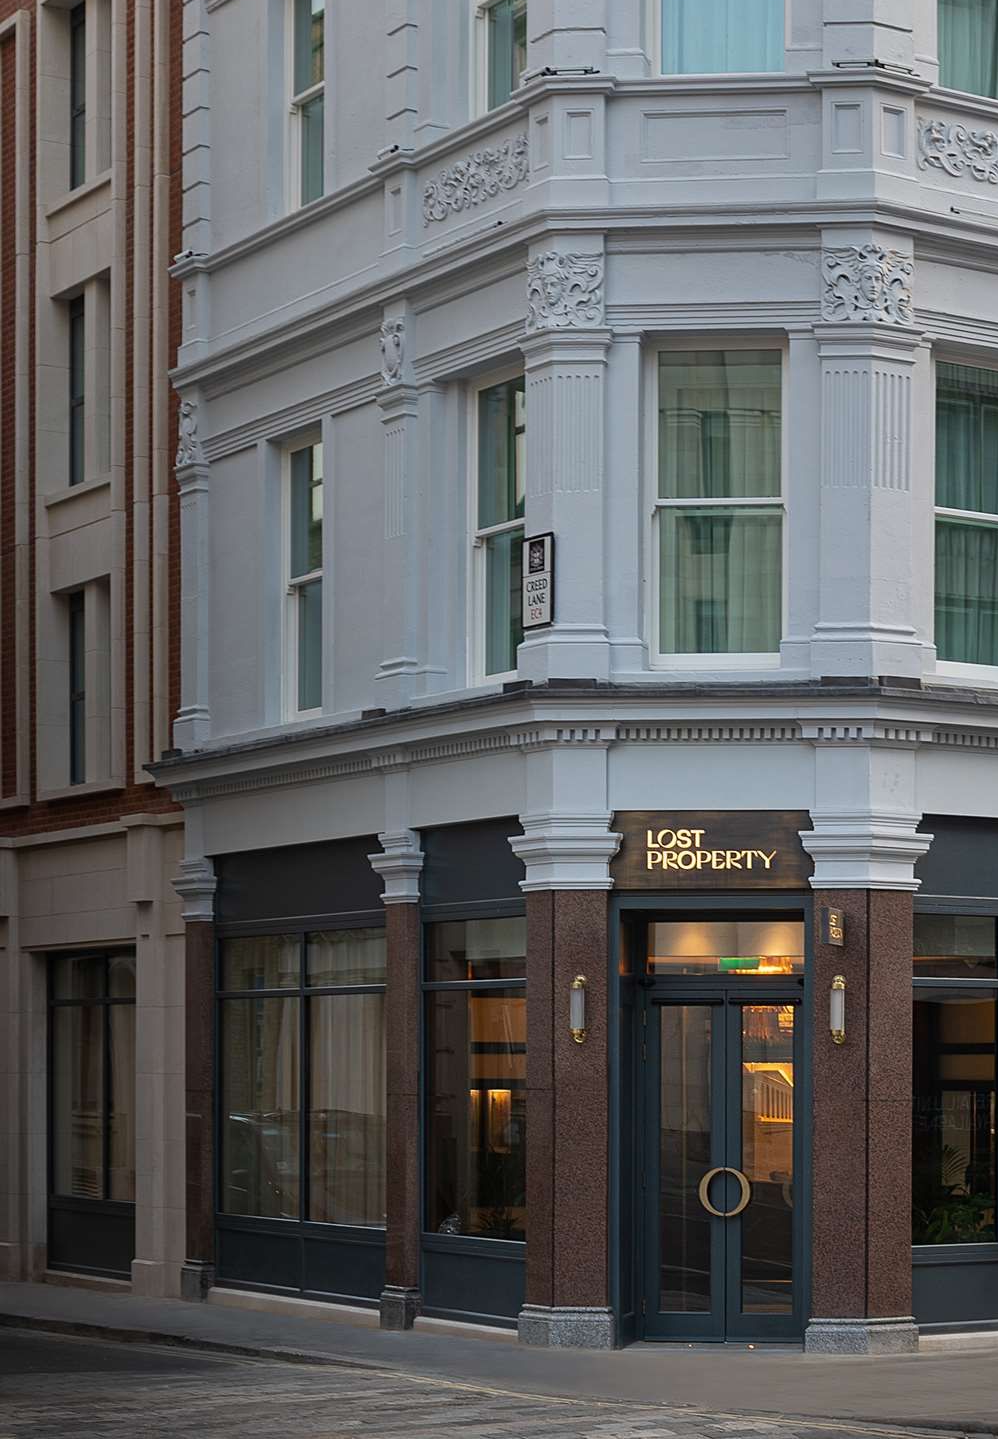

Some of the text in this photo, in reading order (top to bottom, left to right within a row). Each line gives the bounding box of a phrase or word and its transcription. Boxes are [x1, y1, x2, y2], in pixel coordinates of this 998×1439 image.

[526, 578, 548, 593] CREED
[528, 593, 546, 607] LANE
[530, 607, 543, 620] EC4
[647, 829, 705, 848] LOST
[646, 850, 777, 870] PROPERTY
